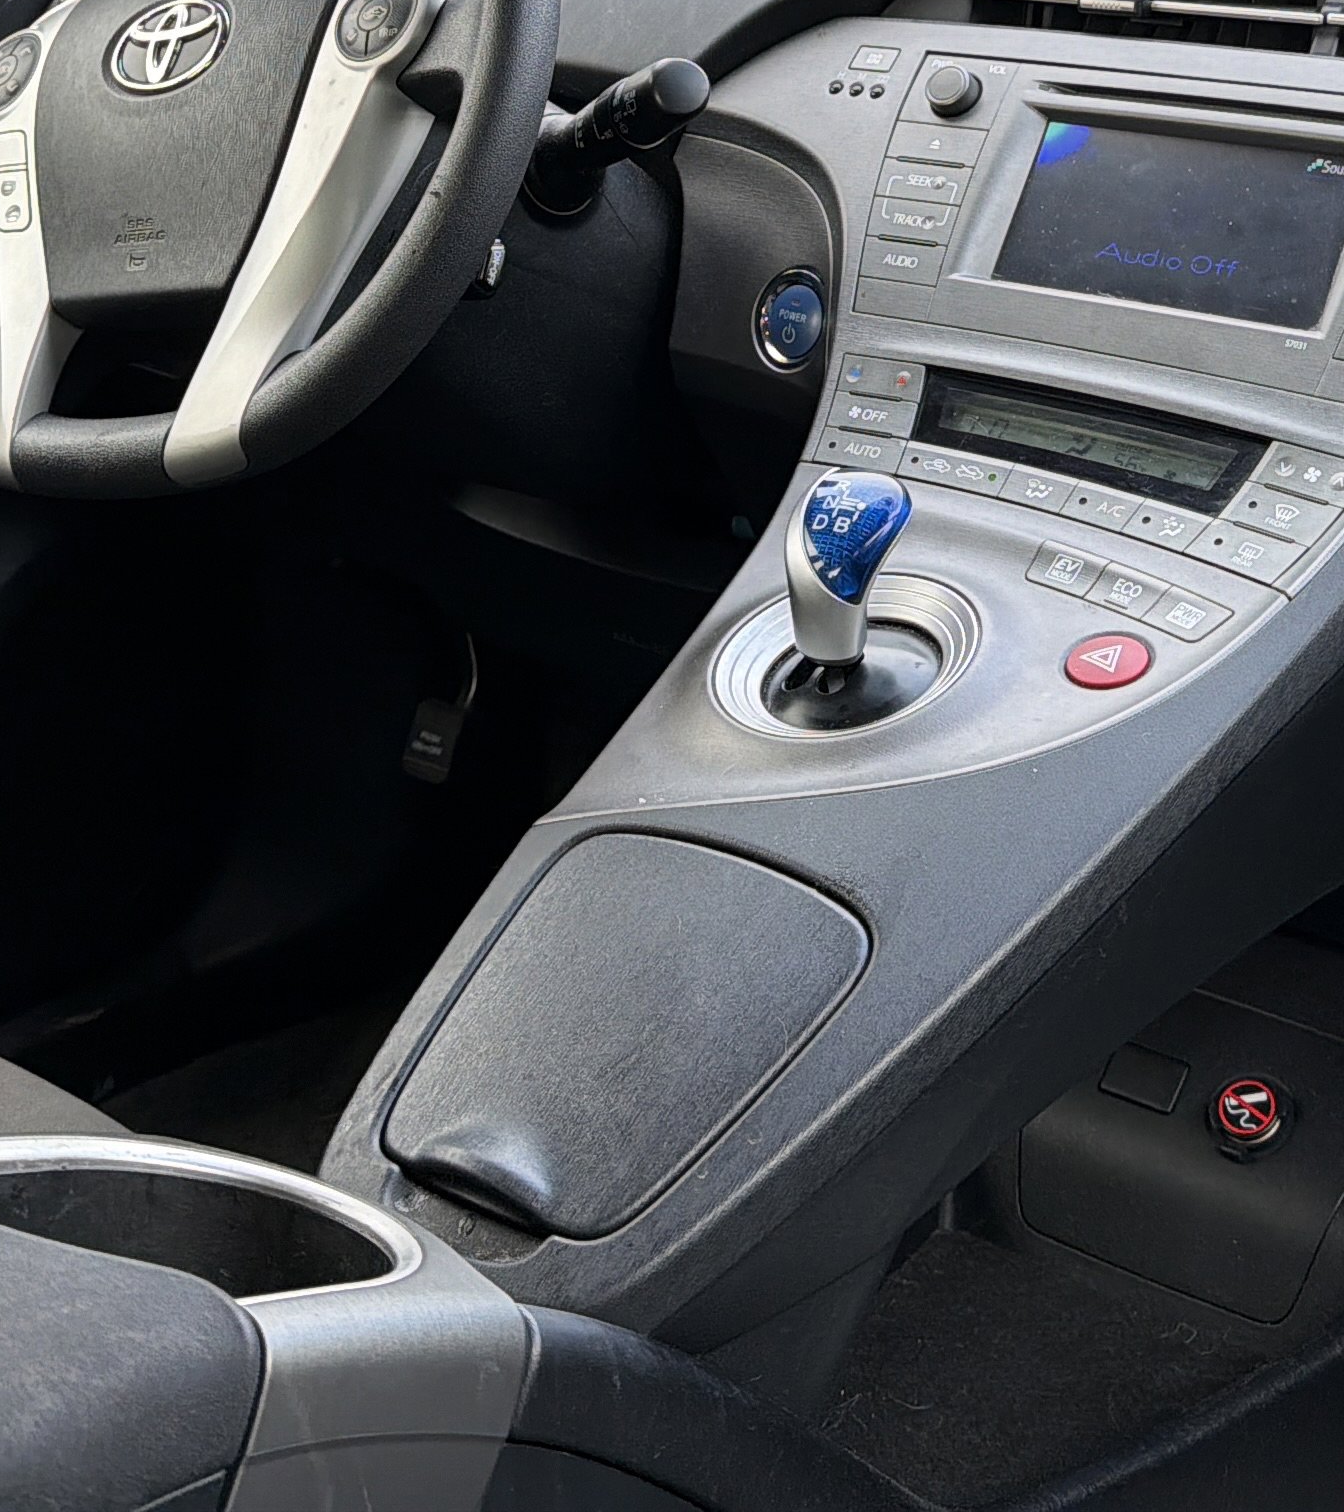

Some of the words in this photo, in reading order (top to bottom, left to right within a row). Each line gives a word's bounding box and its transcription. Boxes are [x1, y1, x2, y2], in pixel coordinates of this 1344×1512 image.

[988, 64, 1007, 76] VOL
[906, 174, 936, 188] SEEK
[892, 212, 926, 227] TRACK
[113, 230, 168, 245] AIRBAG
[882, 253, 919, 269] AUDIO
[1094, 242, 1183, 271] Audio
[1190, 255, 1241, 278] Off
[778, 308, 807, 323] POWER
[861, 408, 889, 423] OFF
[844, 442, 882, 459] AUTO
[822, 495, 840, 510] N
[1095, 500, 1126, 519] A/C
[811, 513, 829, 530] D
[833, 516, 851, 534] B
[1264, 516, 1292, 530] FRONT
[1055, 557, 1081, 573] EV
[1112, 577, 1143, 598] ECO
[1173, 602, 1204, 622] PWR
